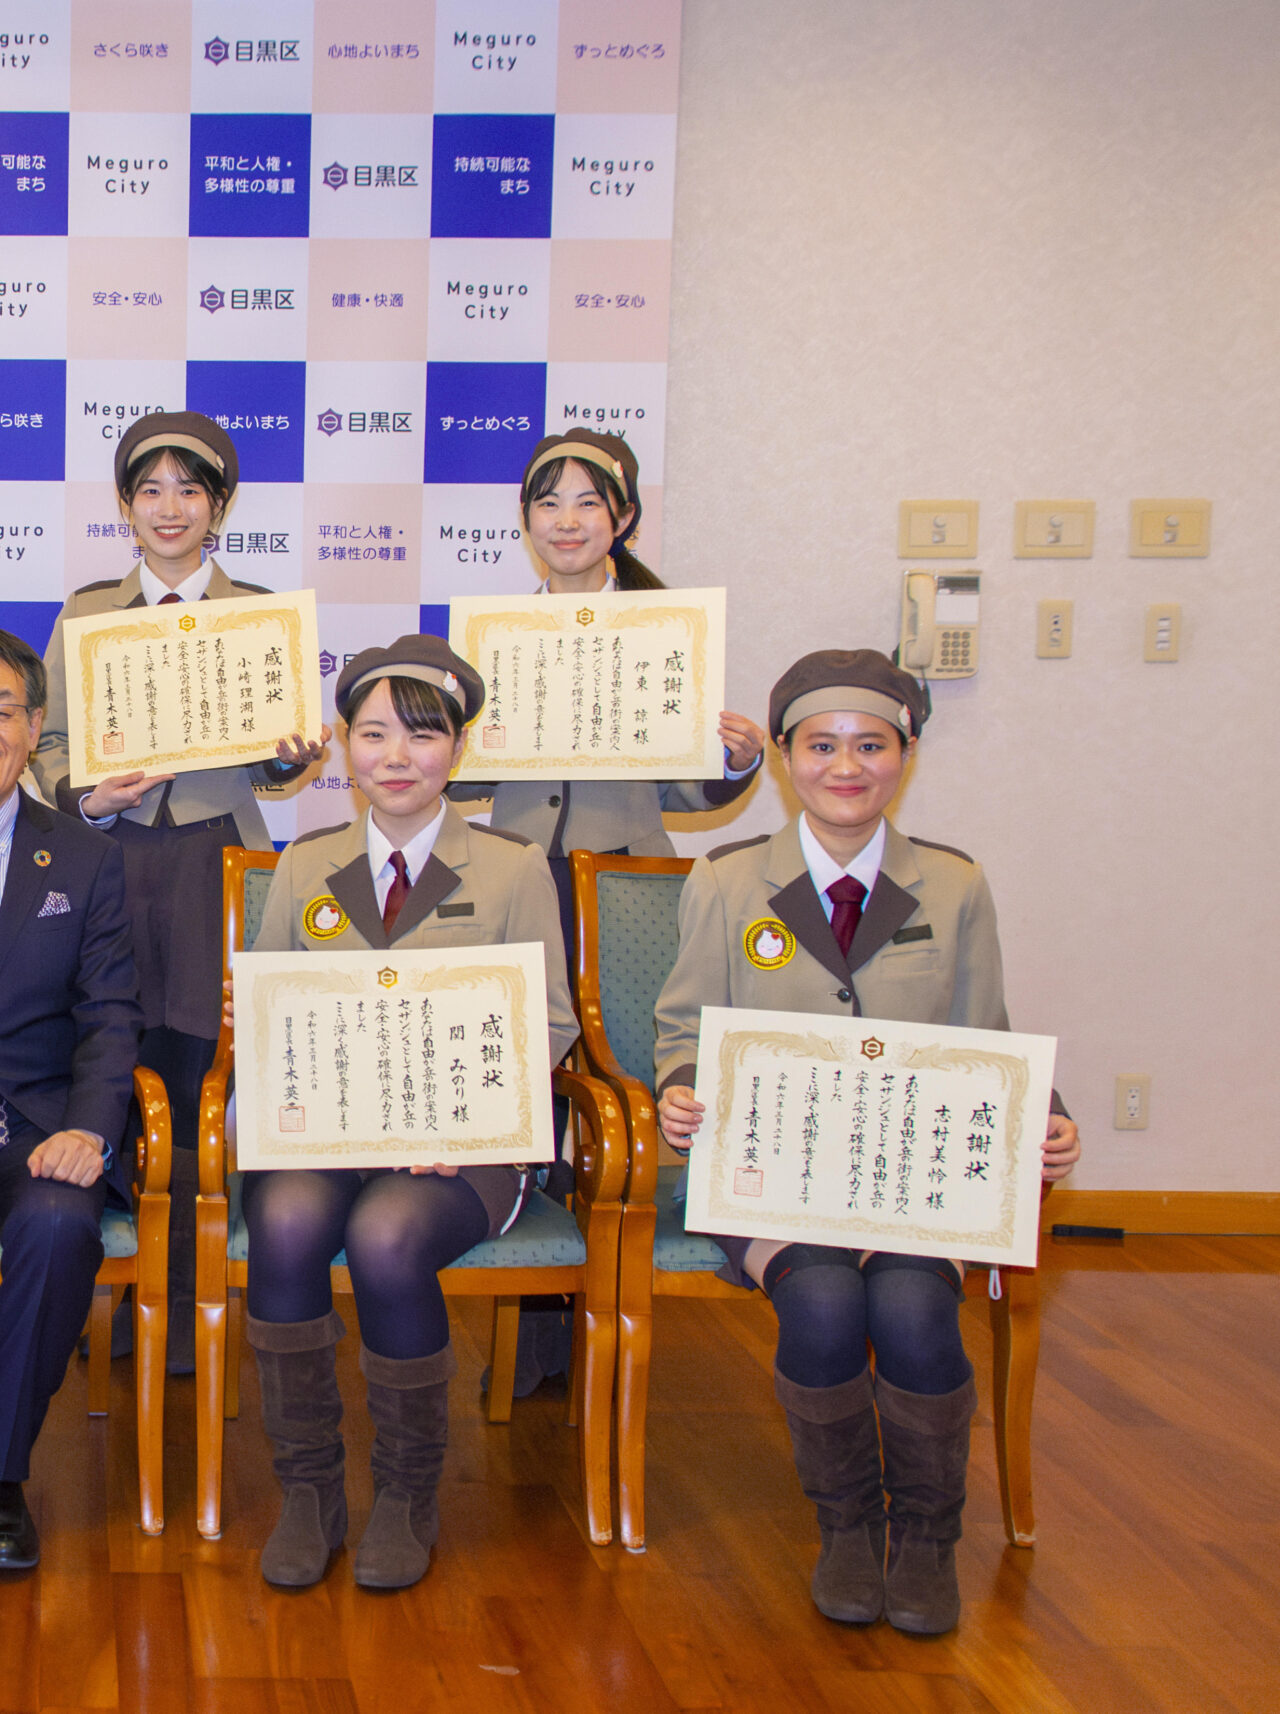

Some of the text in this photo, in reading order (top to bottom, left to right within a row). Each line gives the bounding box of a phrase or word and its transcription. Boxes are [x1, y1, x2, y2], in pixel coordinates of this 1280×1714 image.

[454, 32, 535, 49] Meguro
[94, 43, 168, 57] さくら咲き
[236, 41, 299, 62] 目黒区
[328, 44, 419, 58] 心地よいまち
[575, 44, 664, 58] ずっとめぐろ
[472, 56, 516, 71] City
[88, 156, 168, 173] Meguro
[455, 157, 530, 172] 持続可能な
[572, 158, 653, 174] Meguro
[17, 177, 45, 192] まち
[355, 166, 417, 187] 目黒区
[105, 177, 150, 195] City
[205, 178, 294, 193] 多様性の尊重
[501, 179, 529, 194] まち
[590, 181, 634, 196] City
[93, 292, 162, 305] 安全・安心
[448, 282, 527, 299] Meguro
[232, 289, 294, 310] 目黒区
[332, 294, 403, 307] 健康・快適
[576, 294, 645, 308] 安全・安心
[465, 305, 508, 320] City
[84, 402, 164, 419] Meguro
[564, 405, 644, 422] Meguro
[205, 415, 290, 429] 地よいまち
[349, 412, 411, 432] 目黒区
[441, 416, 530, 430] ずっとめぐろ
[102, 425, 123, 438] Ci
[227, 533, 289, 553] 目黒区
[440, 525, 522, 544] Meguro
[319, 547, 406, 560] 多様性の尊重
[458, 546, 502, 565] City
[263, 647, 284, 703] 感謝状
[662, 651, 685, 714] 感謝状
[104, 686, 120, 738] 青木英二
[488, 677, 502, 731] 青木英二
[356, 1001, 367, 1032] ました
[480, 1014, 504, 1088] 感謝状
[282, 1046, 300, 1112] 青木英二
[449, 1025, 470, 1122] 関みのり様
[832, 1070, 842, 1101] ました
[742, 1107, 762, 1173] 青木英二
[870, 1073, 895, 1208] セザンジュとして自由が丘の
[963, 1102, 997, 1180] 感謝状
